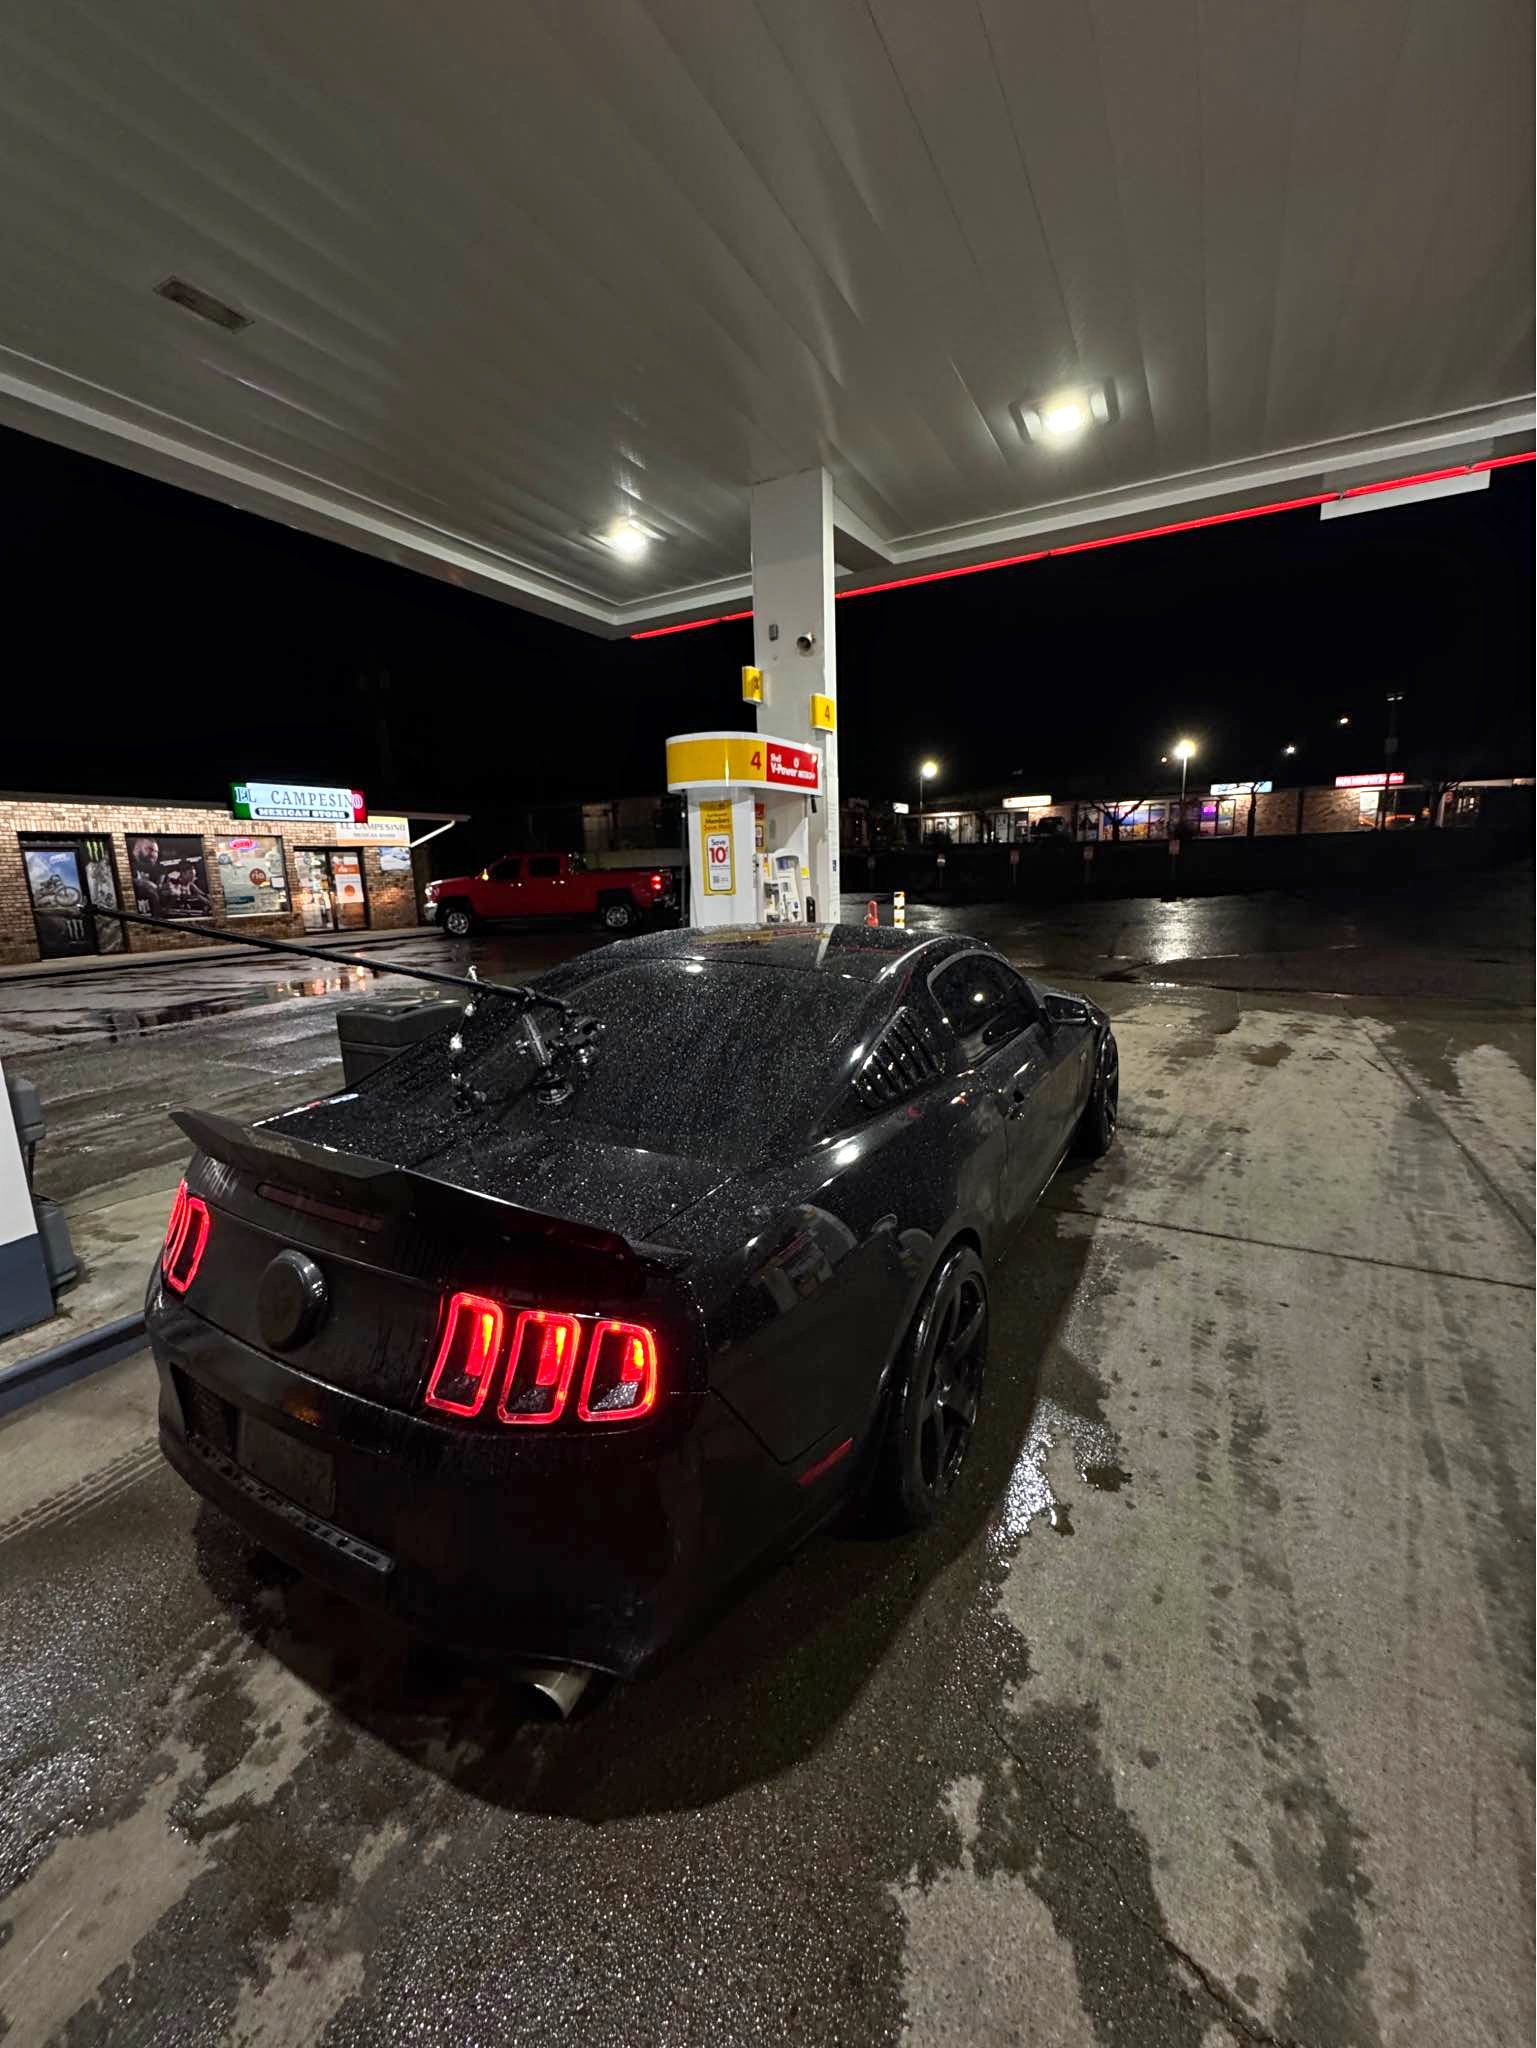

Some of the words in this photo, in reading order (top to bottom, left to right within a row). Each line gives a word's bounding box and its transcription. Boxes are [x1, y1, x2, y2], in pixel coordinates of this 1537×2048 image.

[824, 704, 831, 721] 4
[751, 751, 762, 770] 4
[771, 762, 798, 777] V-Power
[237, 788, 257, 803] EL
[271, 790, 363, 808] CAMPESINO
[258, 808, 311, 818] MEXICAN
[311, 810, 346, 819] STORE
